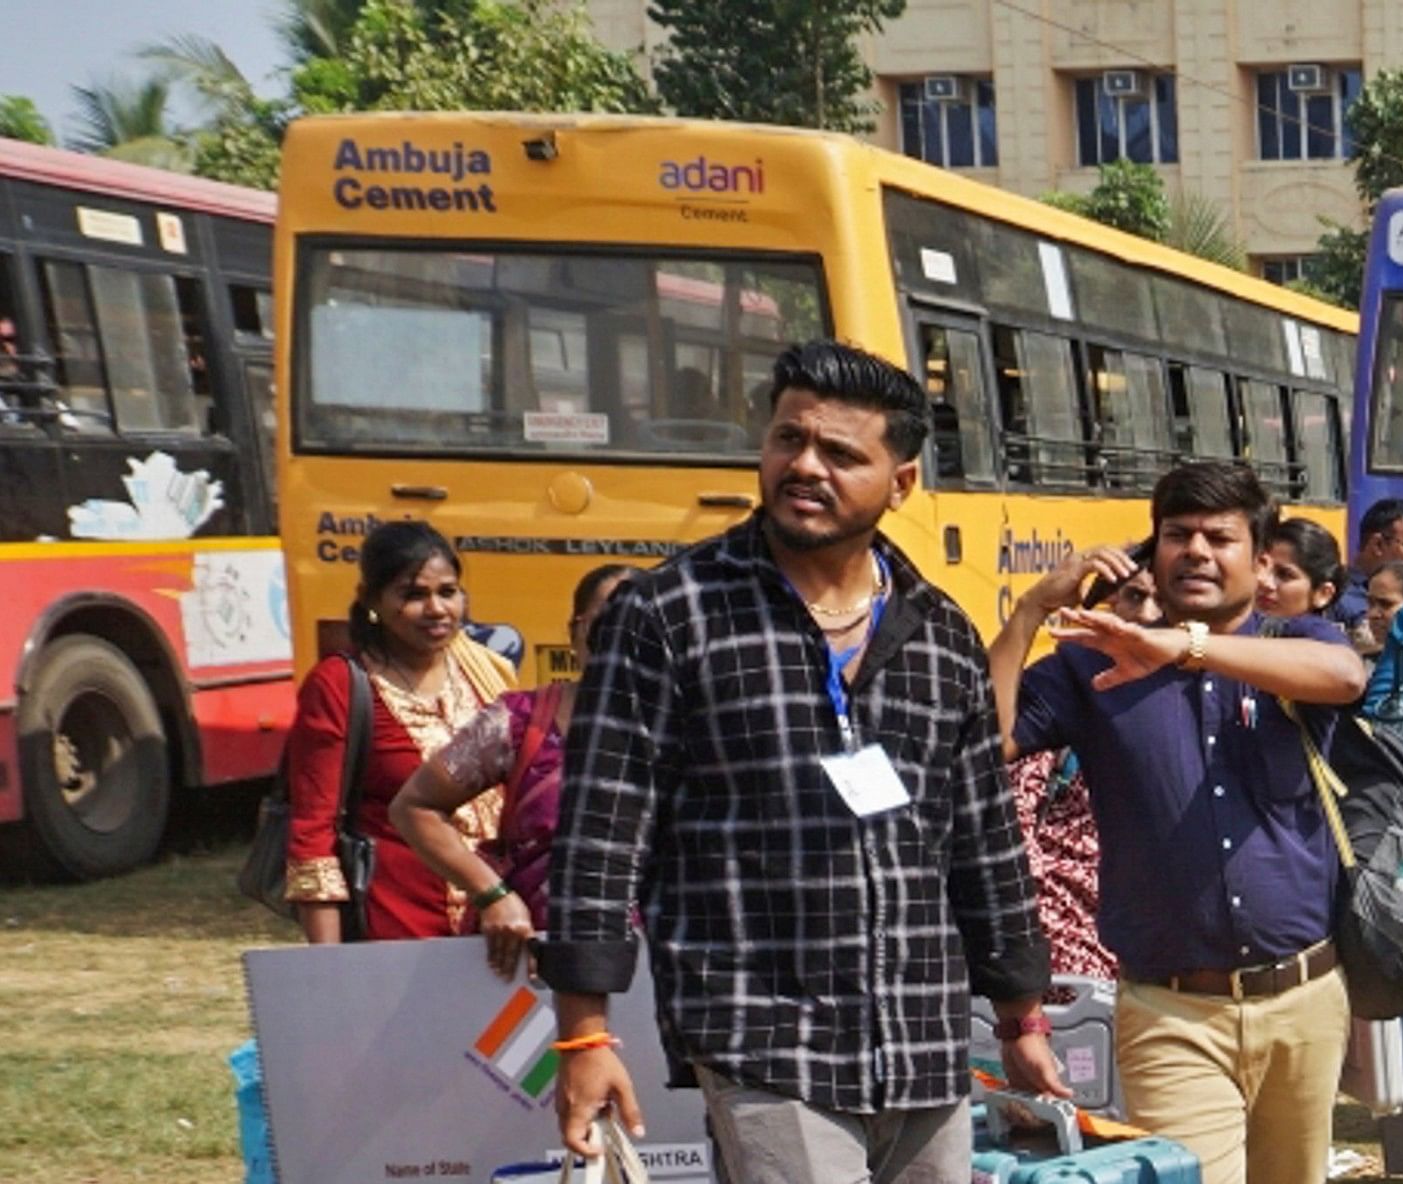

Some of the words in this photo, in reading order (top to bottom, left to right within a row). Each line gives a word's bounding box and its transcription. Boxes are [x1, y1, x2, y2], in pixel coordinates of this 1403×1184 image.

[334, 138, 491, 182] Ambuja
[659, 156, 764, 194] adani
[334, 178, 497, 212] Cement
[681, 204, 749, 223] Cement
[459, 537, 550, 553] ASHOK
